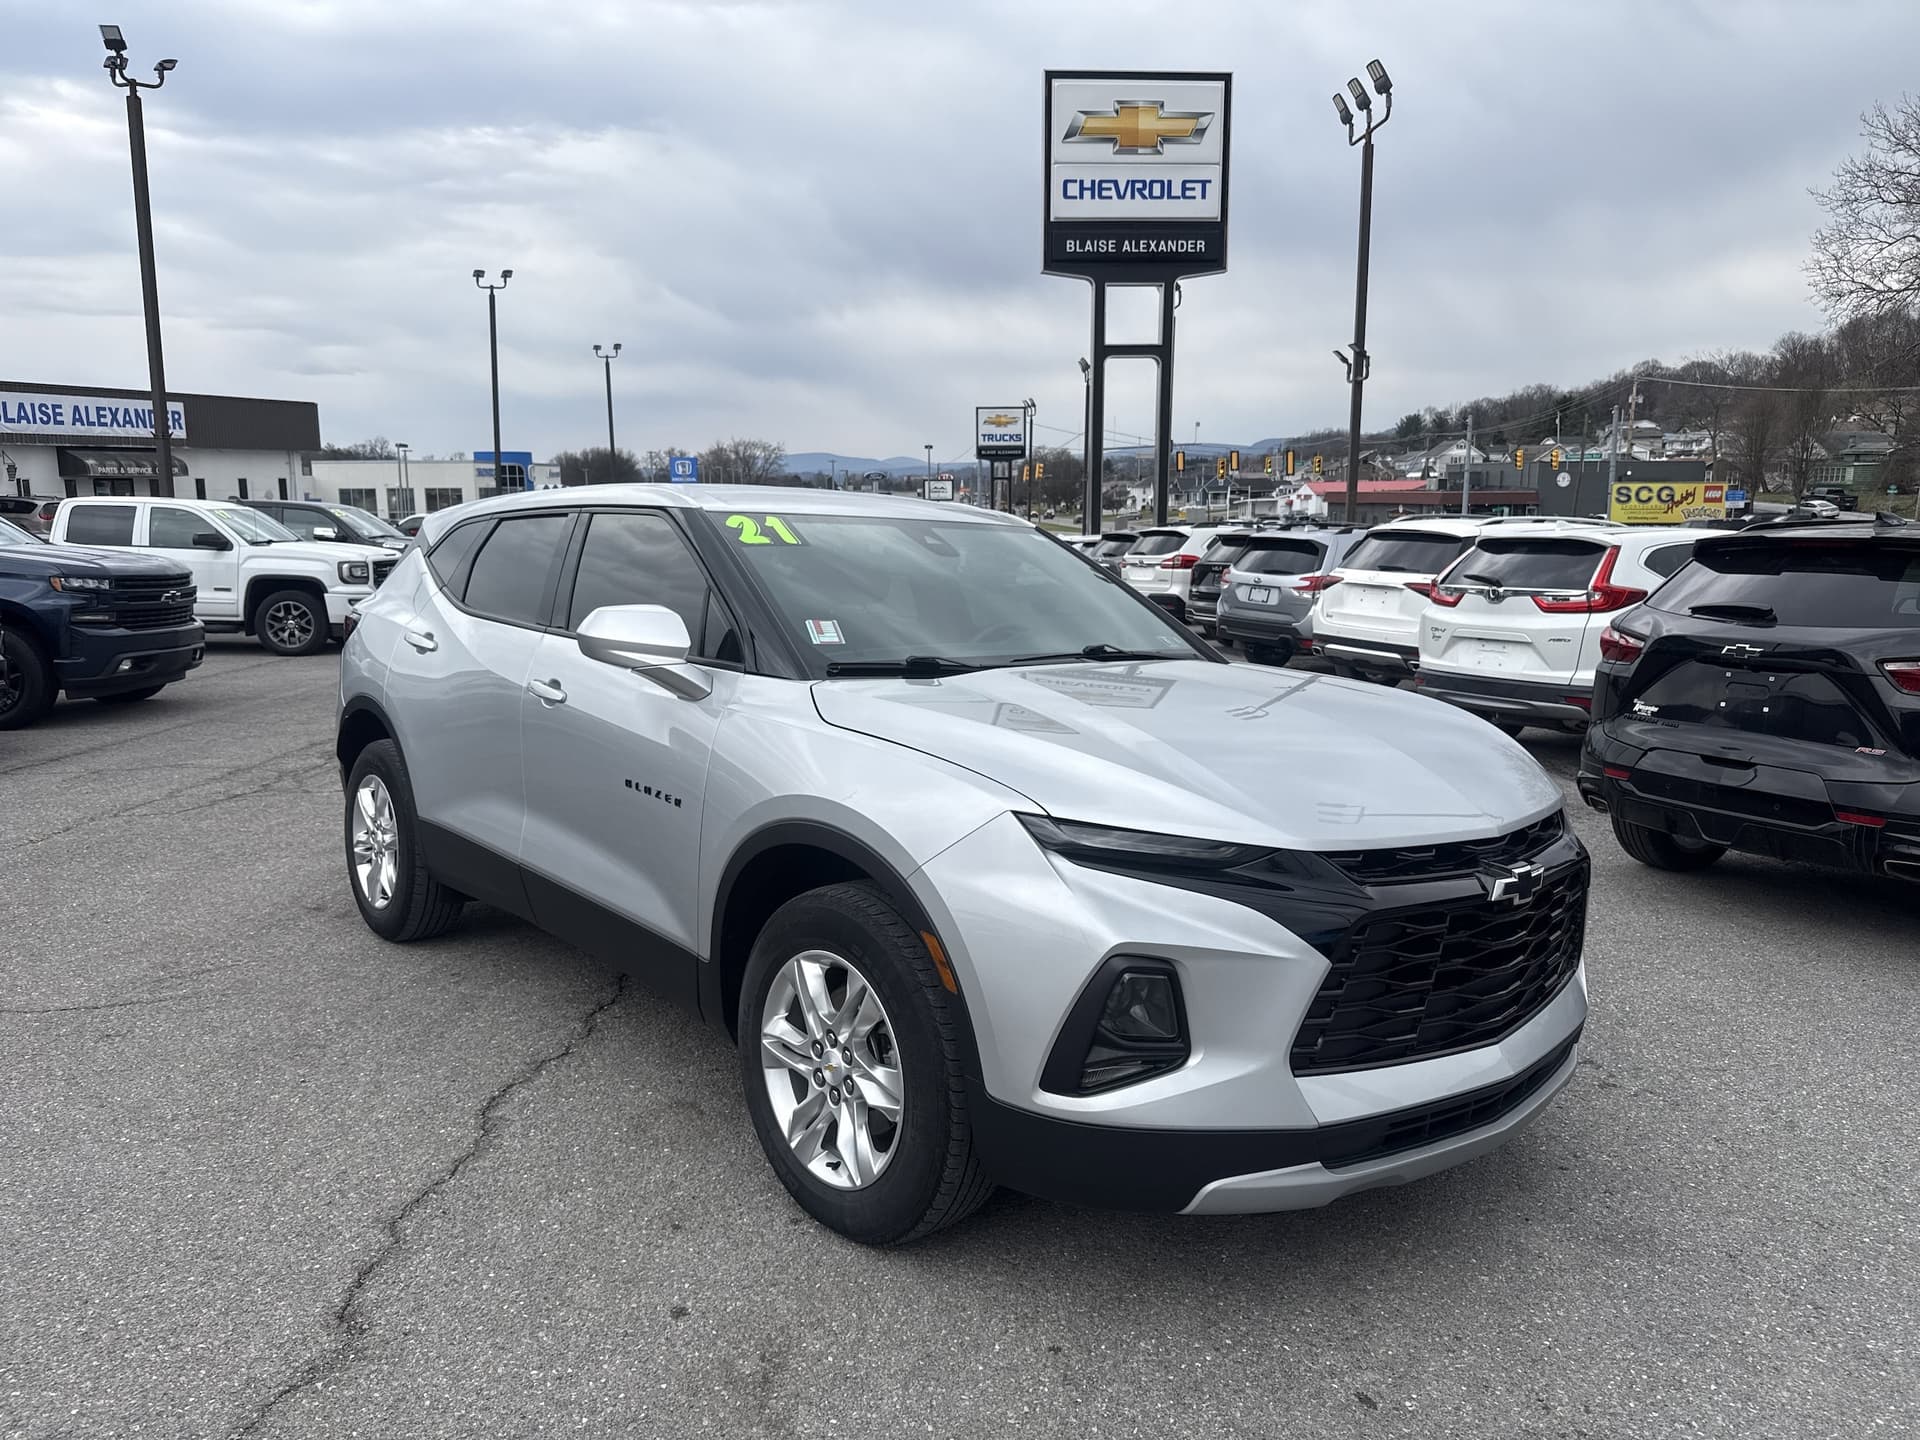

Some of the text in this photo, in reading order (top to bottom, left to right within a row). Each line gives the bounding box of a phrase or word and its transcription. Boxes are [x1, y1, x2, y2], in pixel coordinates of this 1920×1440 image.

[1062, 179, 1212, 200] CHEVROLET
[1066, 240, 1206, 253] BLAISE ALEXANDER
[0, 401, 64, 426] LAISE
[981, 433, 1022, 442] TRUCKS
[1615, 486, 1675, 504] SCG
[1663, 487, 1697, 514] Hobby
[1705, 490, 1722, 498] LEGO
[725, 515, 801, 544] 21
[625, 779, 682, 808] BLAZER
